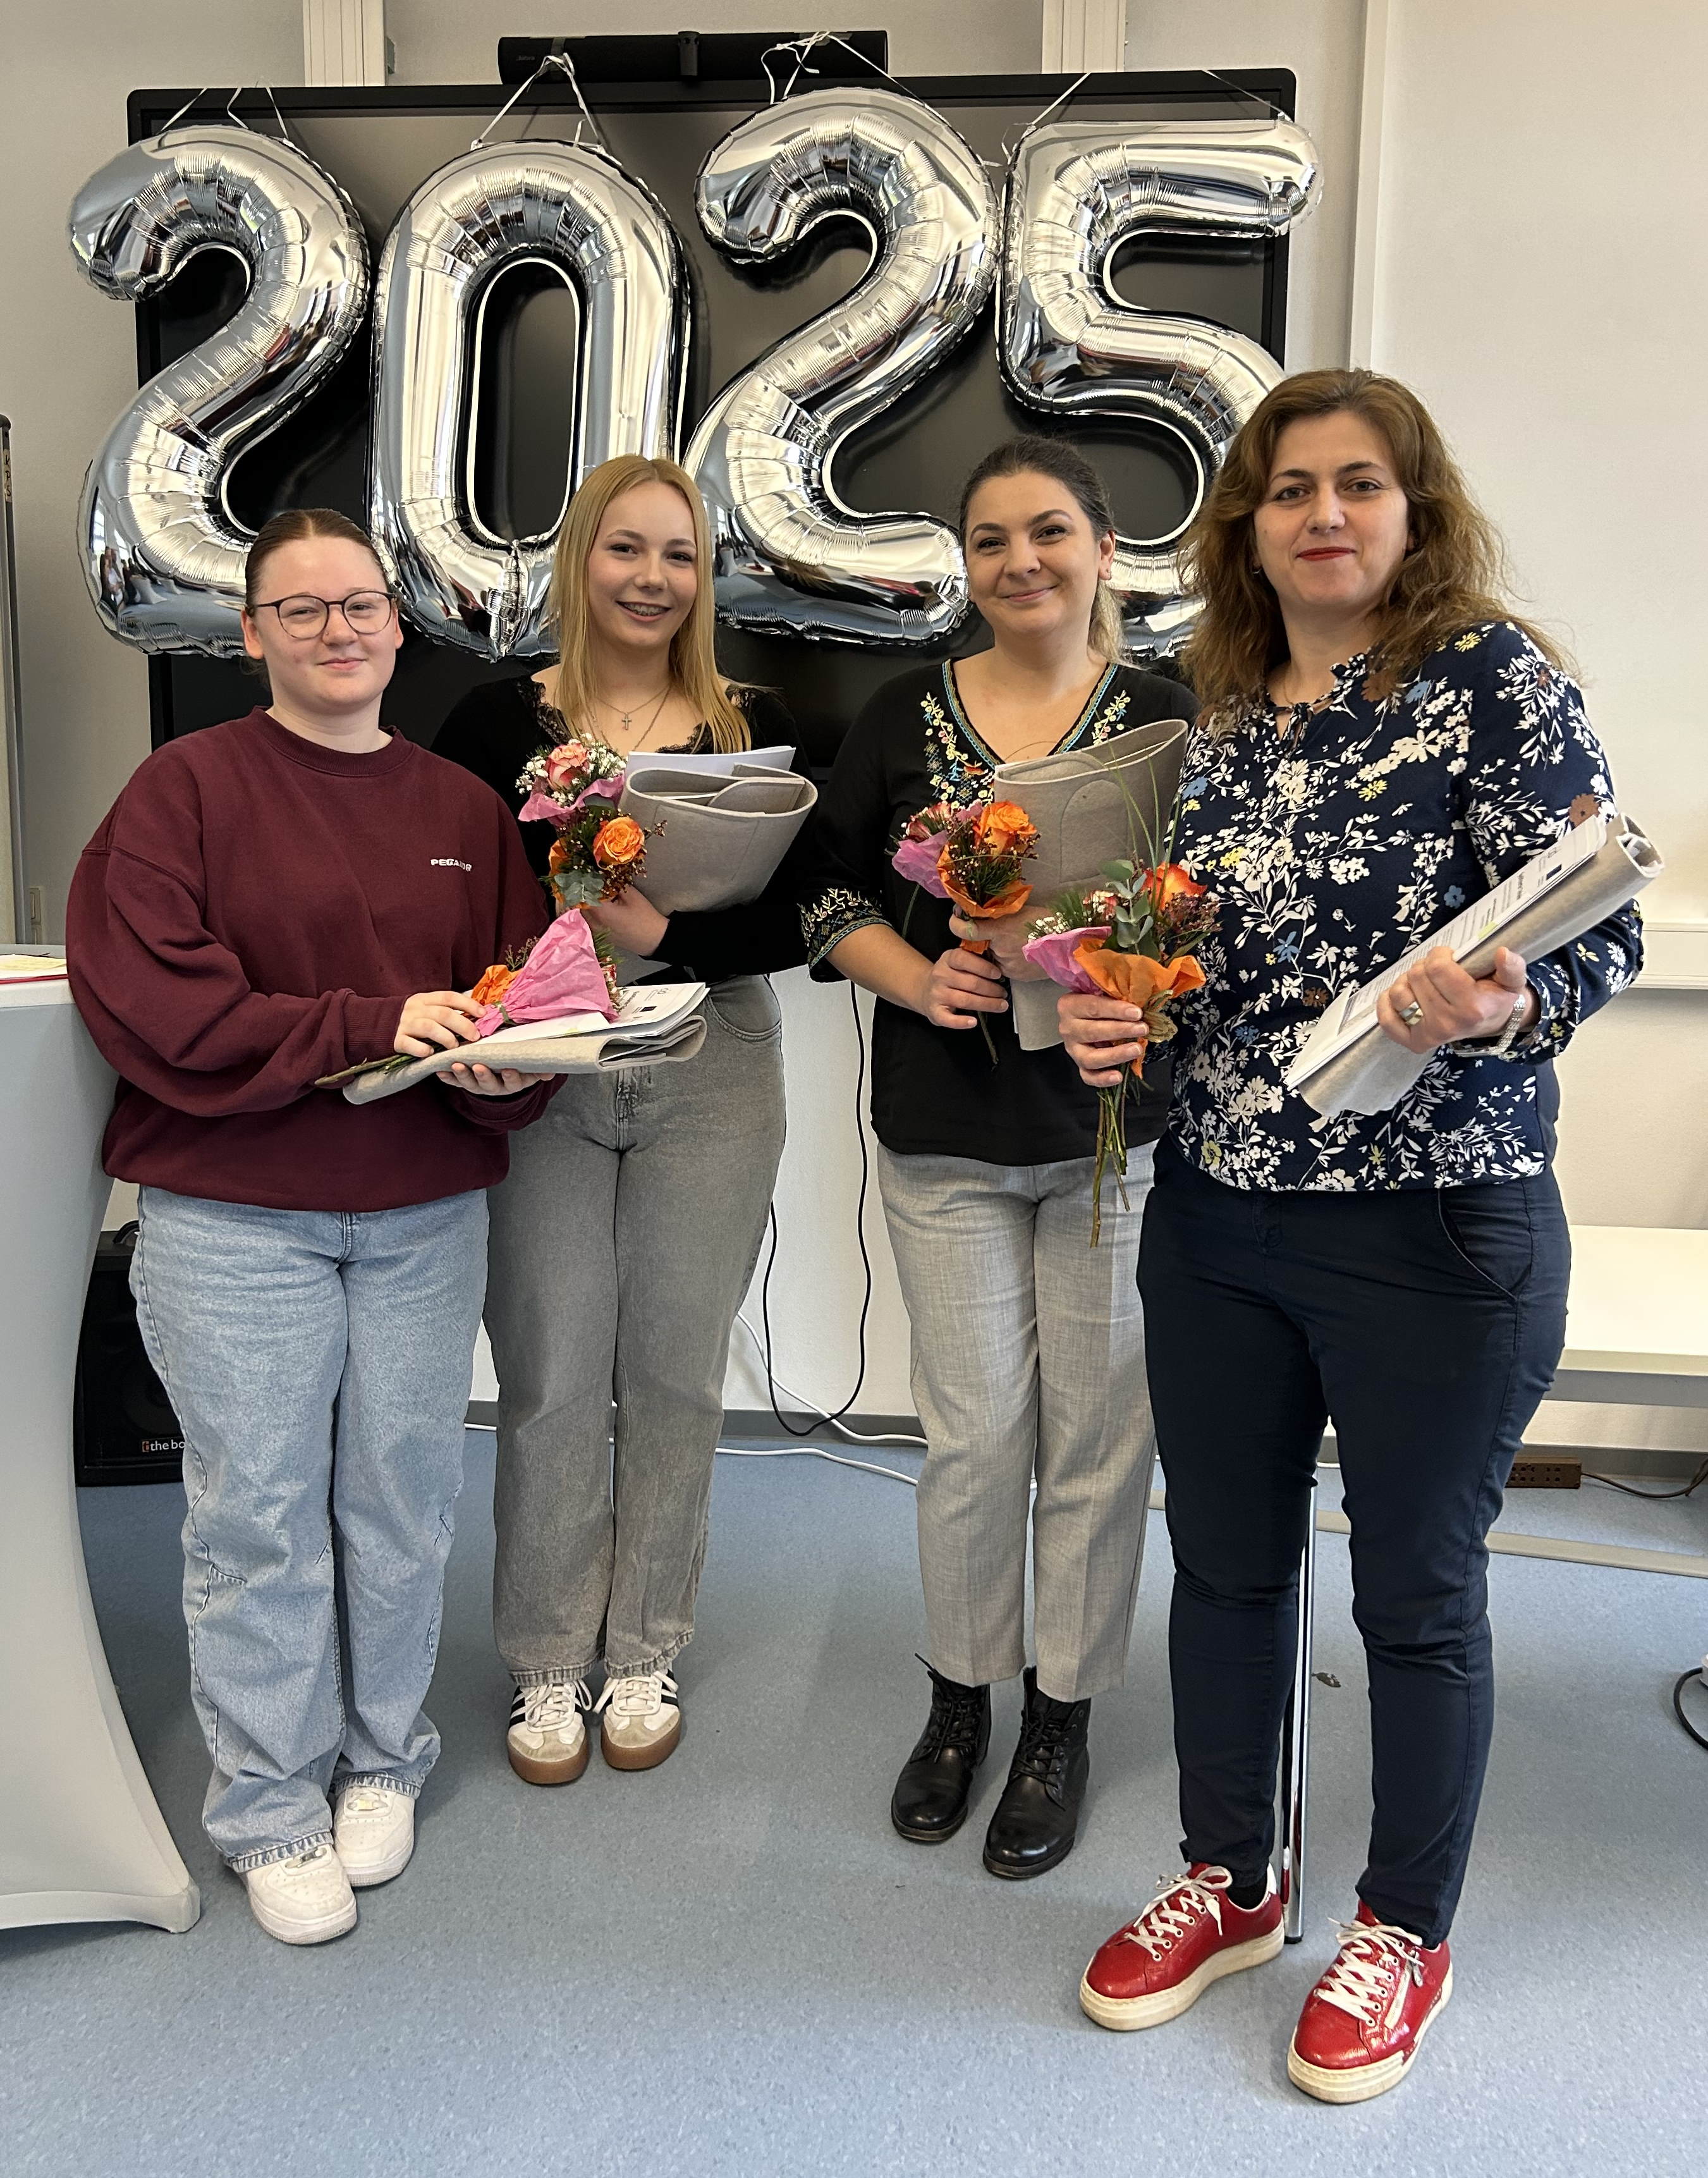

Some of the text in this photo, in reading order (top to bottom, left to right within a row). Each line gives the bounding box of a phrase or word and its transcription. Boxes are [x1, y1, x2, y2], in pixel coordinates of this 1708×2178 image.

[68, 87, 1324, 661] 2025
[150, 1439, 185, 1451] the bo
